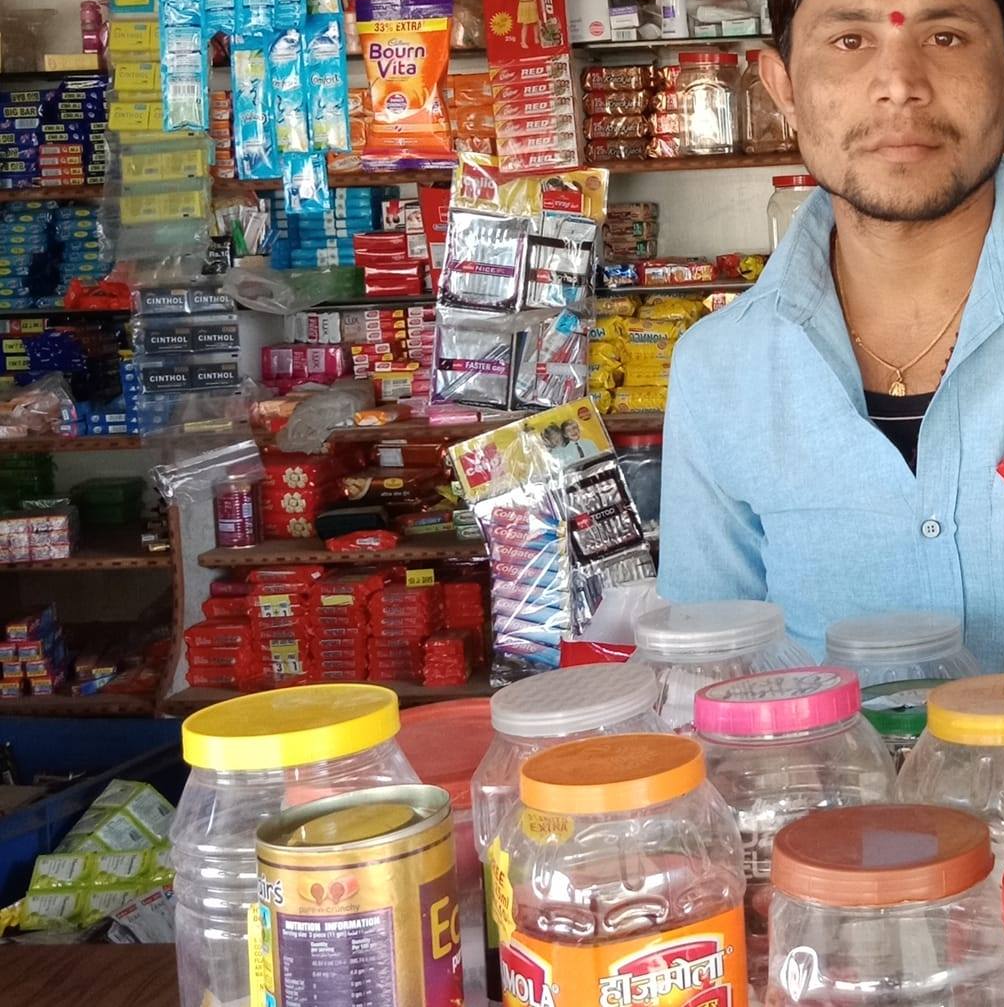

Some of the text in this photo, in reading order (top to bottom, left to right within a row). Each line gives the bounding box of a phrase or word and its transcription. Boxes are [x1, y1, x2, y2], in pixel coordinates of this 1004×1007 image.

[396, 21, 422, 32] EXTRA
[369, 43, 425, 59] Bourn
[377, 58, 417, 79] Vita
[521, 67, 544, 78] RED
[523, 85, 546, 95] RED
[20, 107, 36, 115] BAR
[524, 102, 547, 112] RED
[526, 120, 549, 130] RED
[528, 138, 551, 146] RED
[529, 155, 552, 165] RED
[146, 296, 184, 305] CINTHOL
[194, 295, 230, 304] CINTHOL
[150, 335, 188, 344] CINTHOL
[198, 334, 235, 343] CINTHOL
[465, 361, 491, 371] FASTER
[149, 374, 187, 383] CINTHOL
[198, 371, 234, 381] CINTHOL
[495, 544, 535, 559] Colgate
[529, 821, 568, 833] EXTRA
[285, 917, 380, 932] NUTRITION INFORMATION
